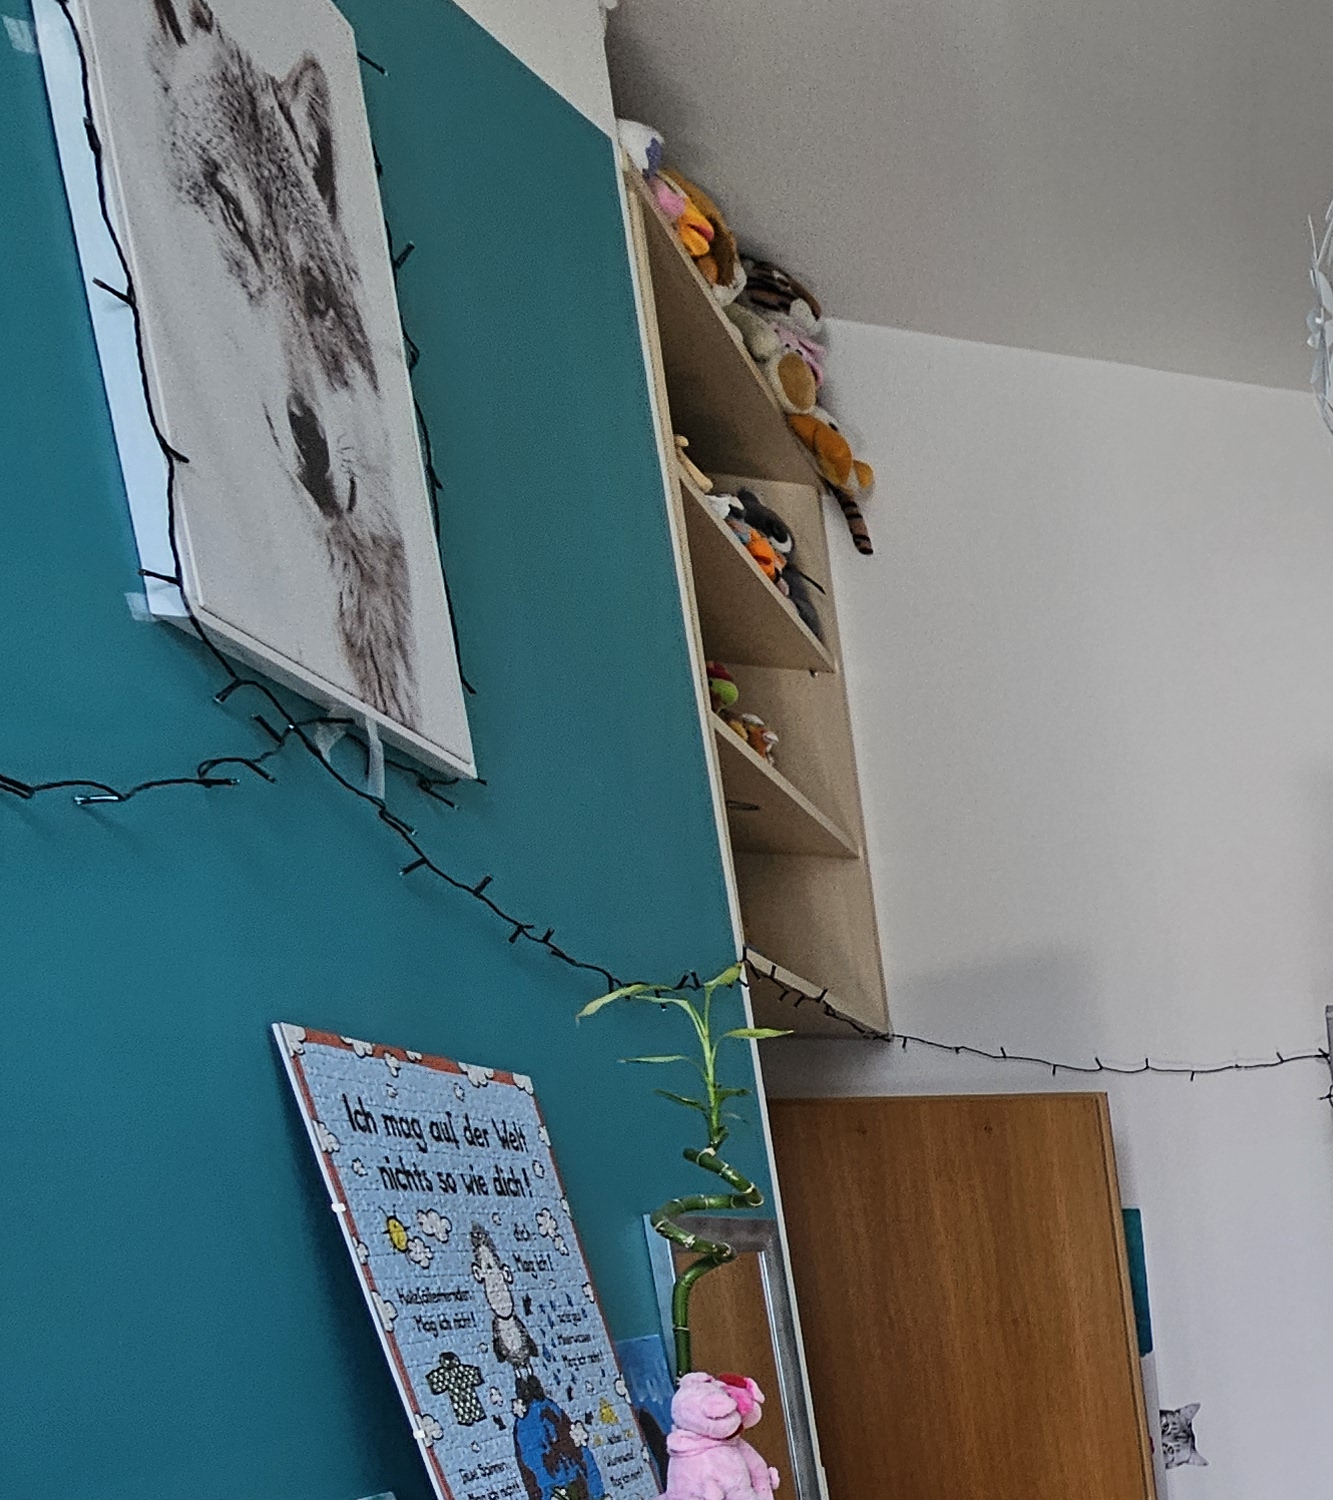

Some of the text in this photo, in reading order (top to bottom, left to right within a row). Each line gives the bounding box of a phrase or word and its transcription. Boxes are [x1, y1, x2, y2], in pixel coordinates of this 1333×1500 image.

[341, 1092, 529, 1153] Ich mag auf der Welt
[377, 1155, 533, 1198] nichts so wie dich!
